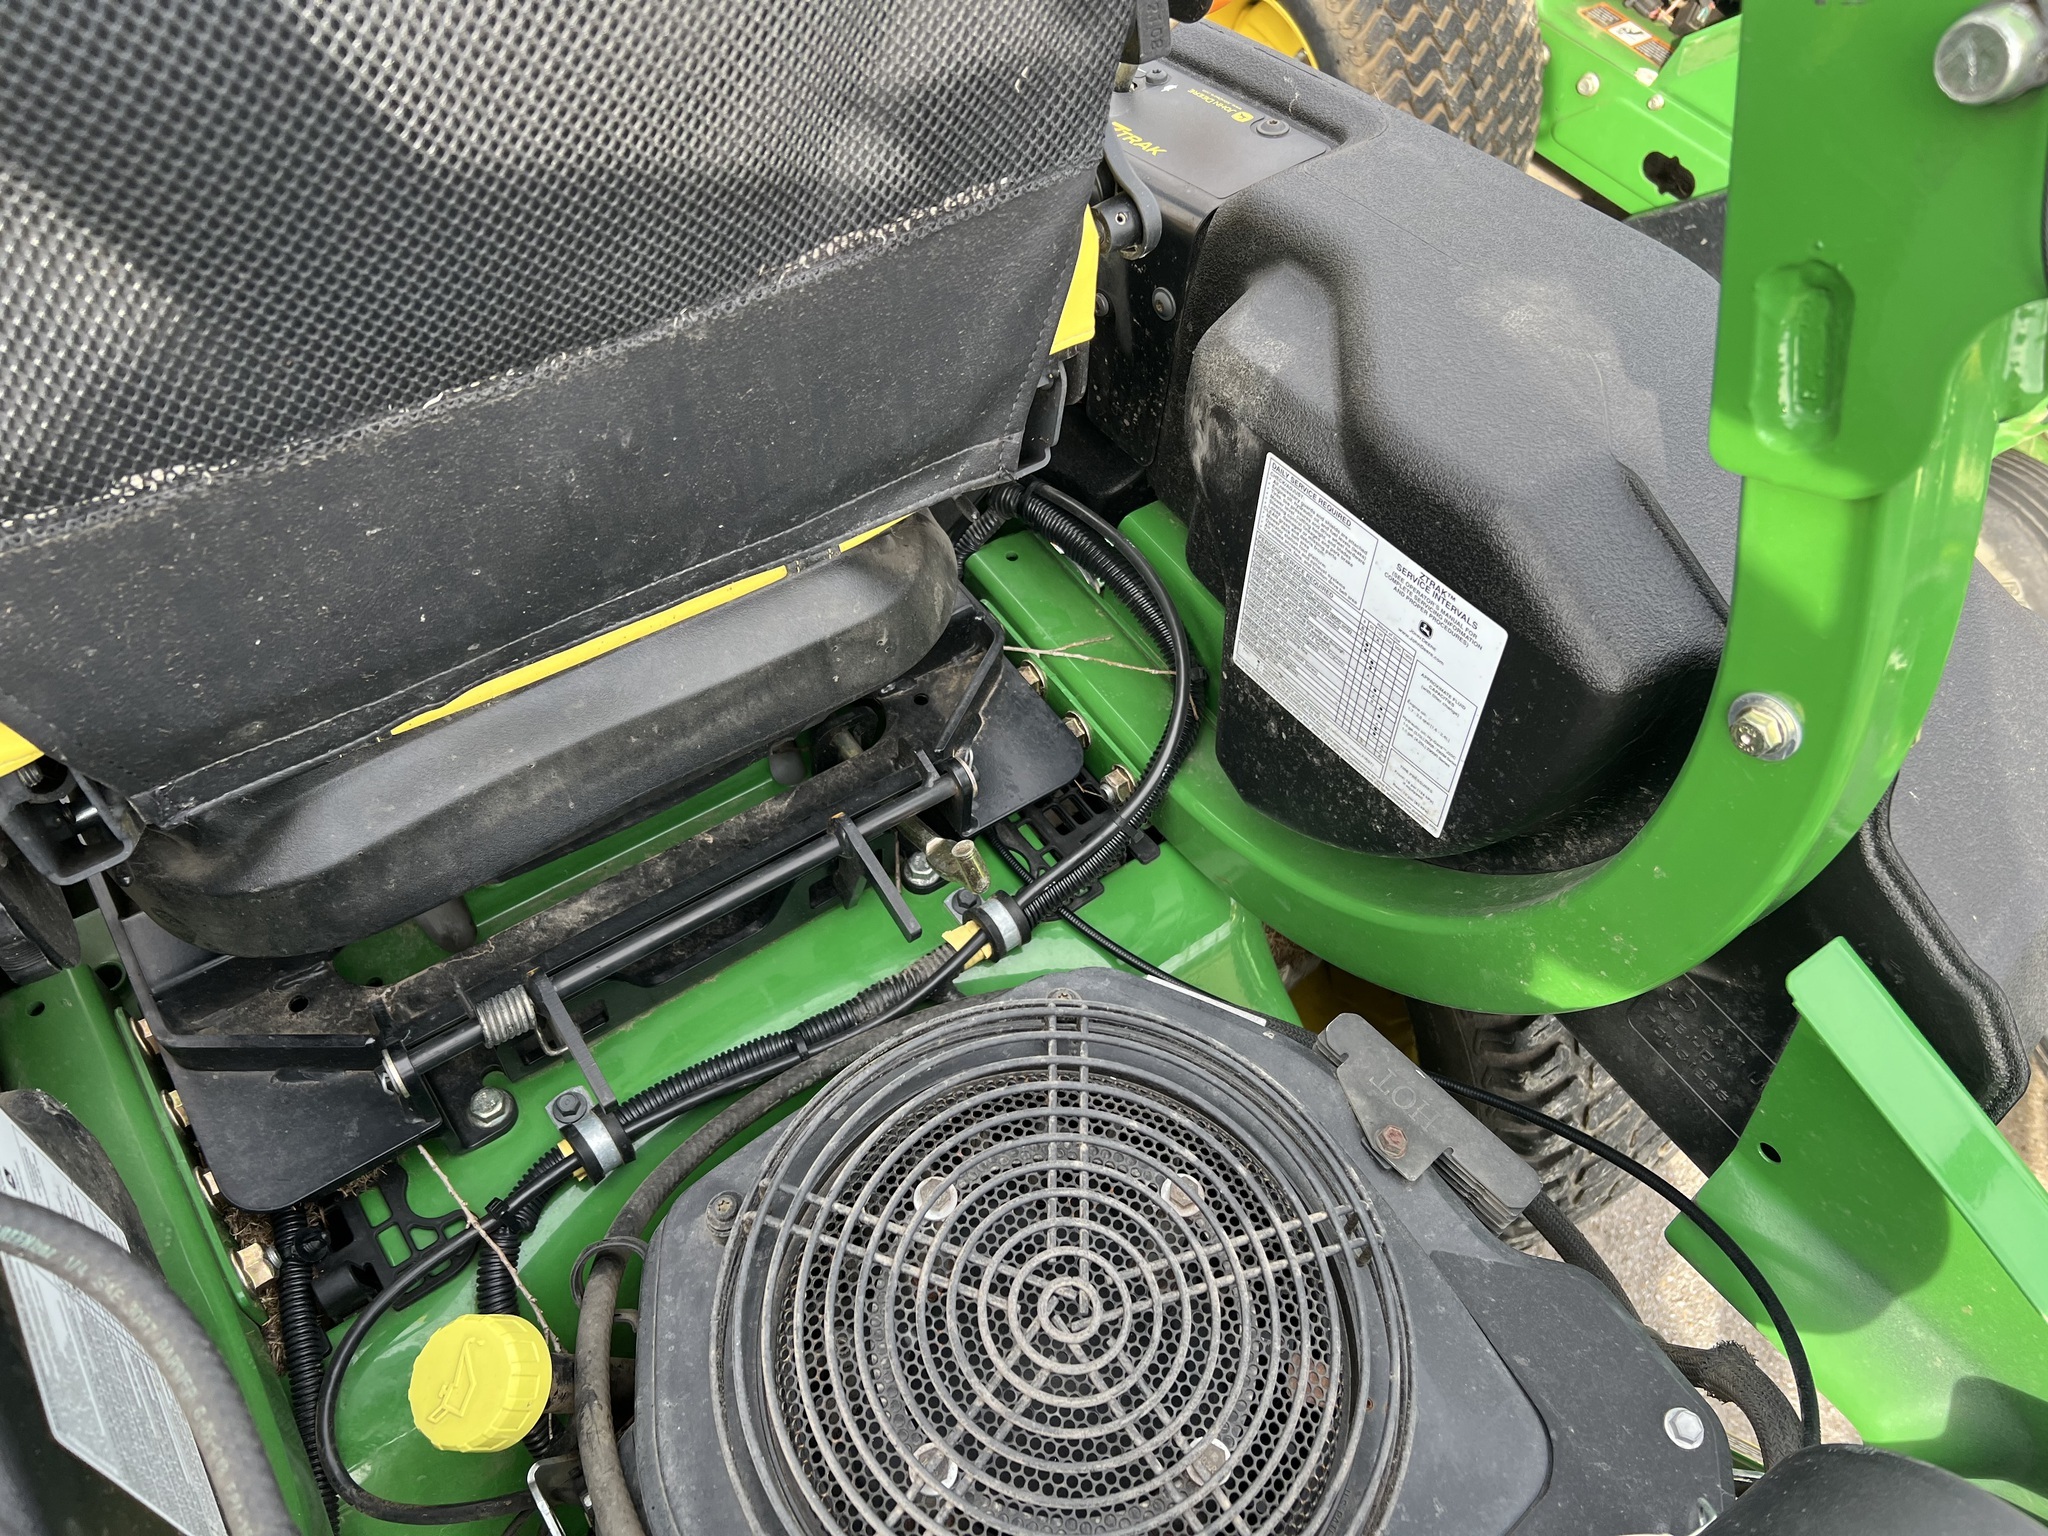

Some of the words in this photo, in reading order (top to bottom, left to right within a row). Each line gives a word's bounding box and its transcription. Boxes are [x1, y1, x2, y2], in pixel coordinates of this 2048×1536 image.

[1271, 461, 1289, 480] DAILY
[1289, 475, 1317, 502] SERVICE
[1317, 496, 1352, 528] REQUIRED
[1383, 570, 1413, 598] COMPLETE
[1413, 593, 1443, 621] SERVICING
[1442, 616, 1483, 651] INFORMATION
[1391, 569, 1405, 585] (SEE
[1404, 580, 1440, 612] OPERATOR'S
[1439, 607, 1464, 630] MANUAL
[1464, 625, 1478, 640] FOR
[1392, 584, 1405, 599] AND
[1404, 594, 1428, 616] PROPER
[1427, 612, 1469, 648] PROCEDURES)
[1395, 562, 1431, 595] SERVICE
[1431, 589, 1479, 631] INTERVALS
[1368, 1068, 1442, 1133] HOT
